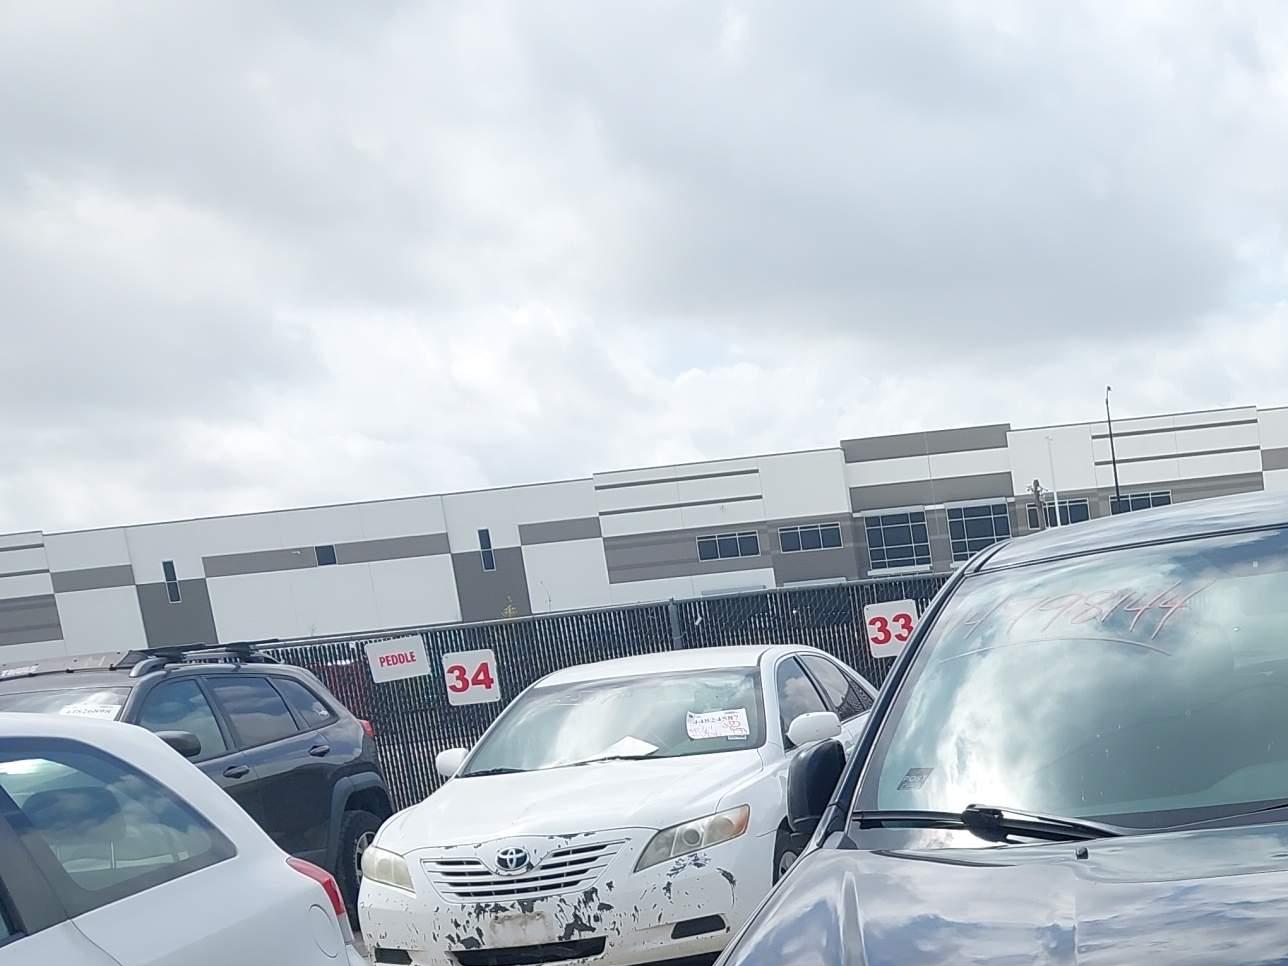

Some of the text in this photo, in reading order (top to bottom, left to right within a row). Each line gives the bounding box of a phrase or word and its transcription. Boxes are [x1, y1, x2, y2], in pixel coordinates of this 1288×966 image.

[868, 613, 914, 644] 33
[379, 651, 416, 667] PEDDLE
[447, 662, 494, 692] 34
